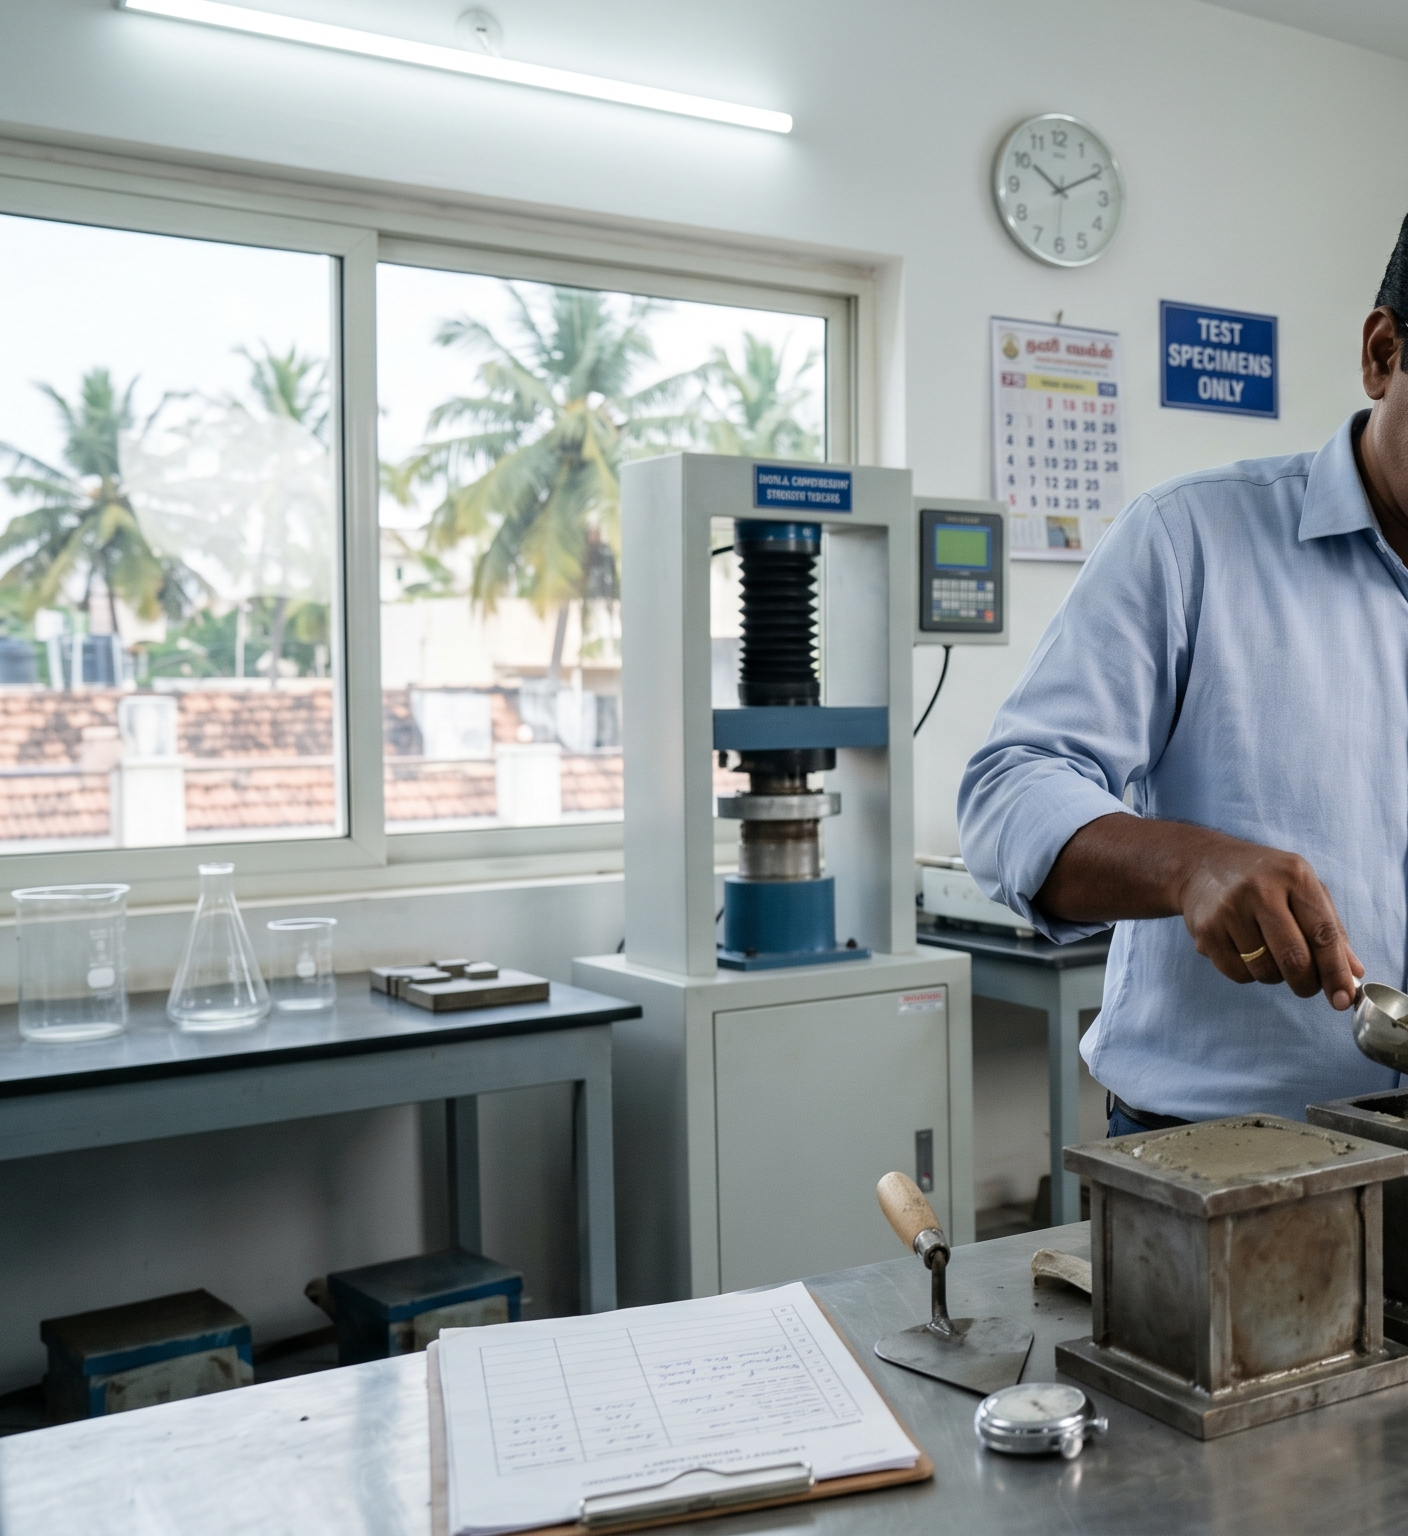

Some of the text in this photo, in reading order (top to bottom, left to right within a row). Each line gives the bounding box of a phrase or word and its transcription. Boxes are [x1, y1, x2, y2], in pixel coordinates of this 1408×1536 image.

[1031, 134, 1044, 151] 11
[1052, 130, 1067, 148] 12
[1078, 142, 1084, 158] 1
[1015, 152, 1031, 169] 10
[1092, 163, 1101, 180] 2
[1009, 175, 1020, 193] 9
[1098, 191, 1109, 208] 3
[1016, 204, 1027, 221] 8
[1092, 216, 1102, 231] 4
[1033, 225, 1043, 243] 7
[1077, 233, 1087, 249] 5
[1054, 237, 1065, 254] 6
[1197, 317, 1243, 346] TEST
[1167, 343, 1273, 379] SPECIMENS
[1197, 375, 1245, 403] ONLY
